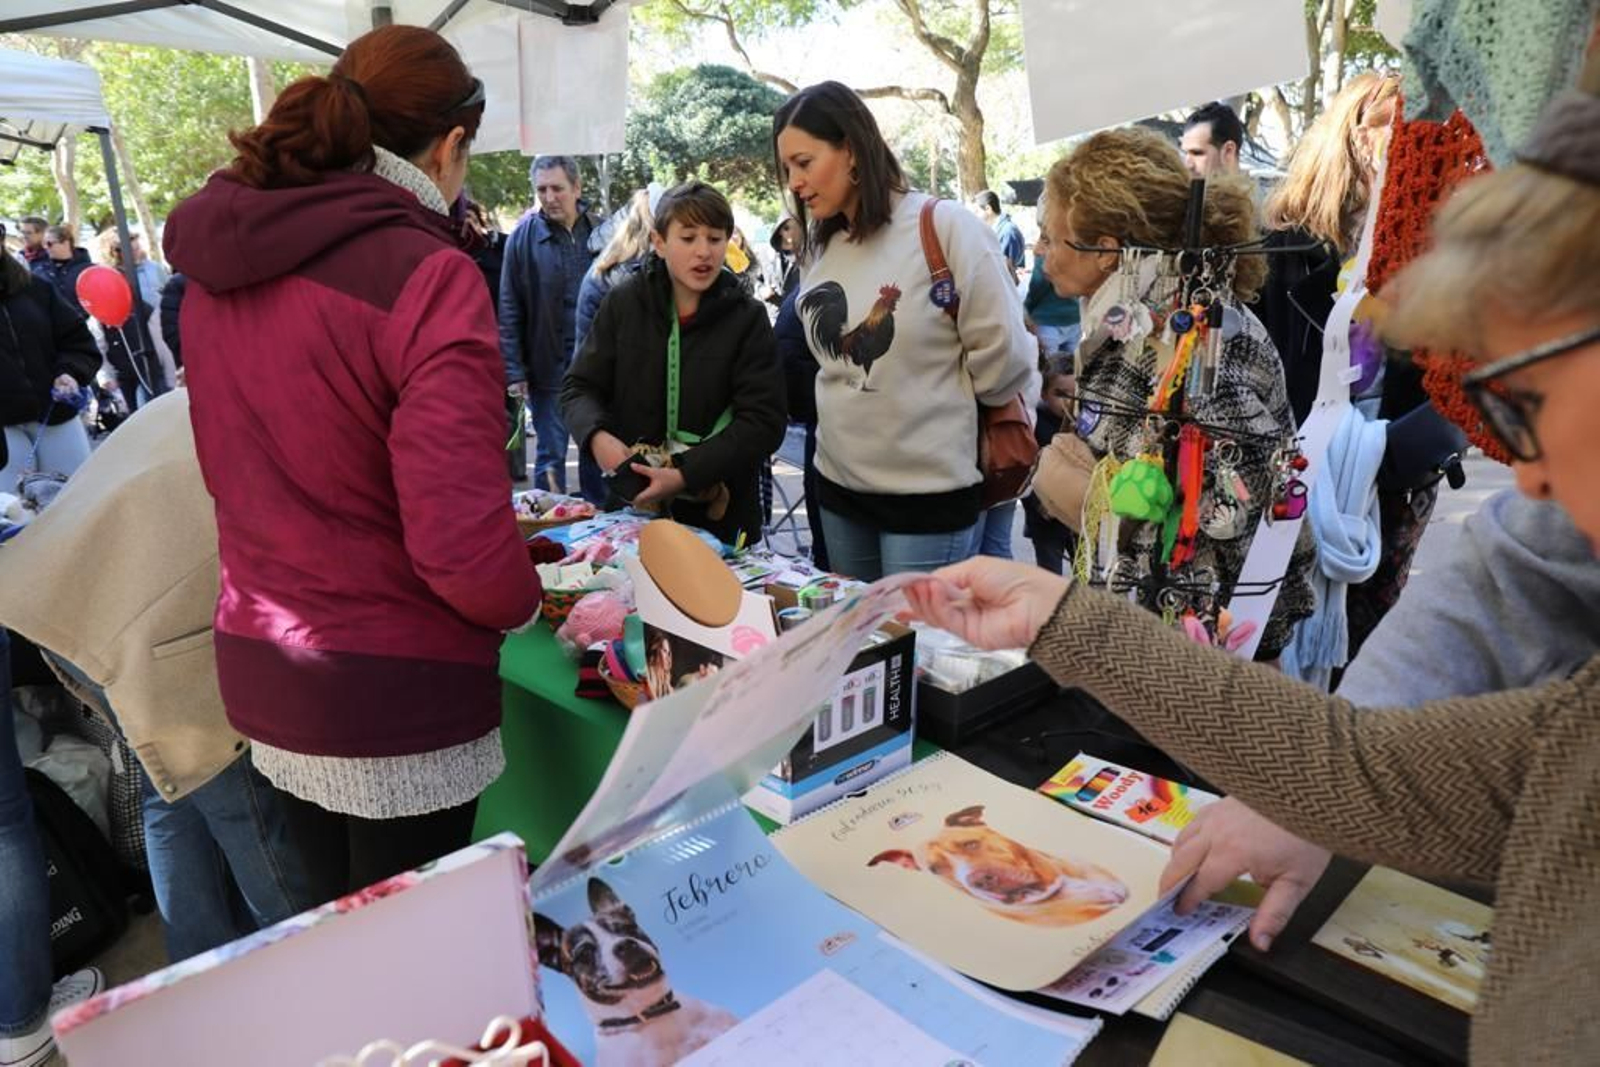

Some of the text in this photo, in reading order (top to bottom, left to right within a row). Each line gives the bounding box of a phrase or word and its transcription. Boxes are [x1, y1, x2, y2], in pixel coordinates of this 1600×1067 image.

[889, 669, 901, 720] HEALTH
[1092, 771, 1144, 811] Woody
[663, 852, 773, 925] Febrero
